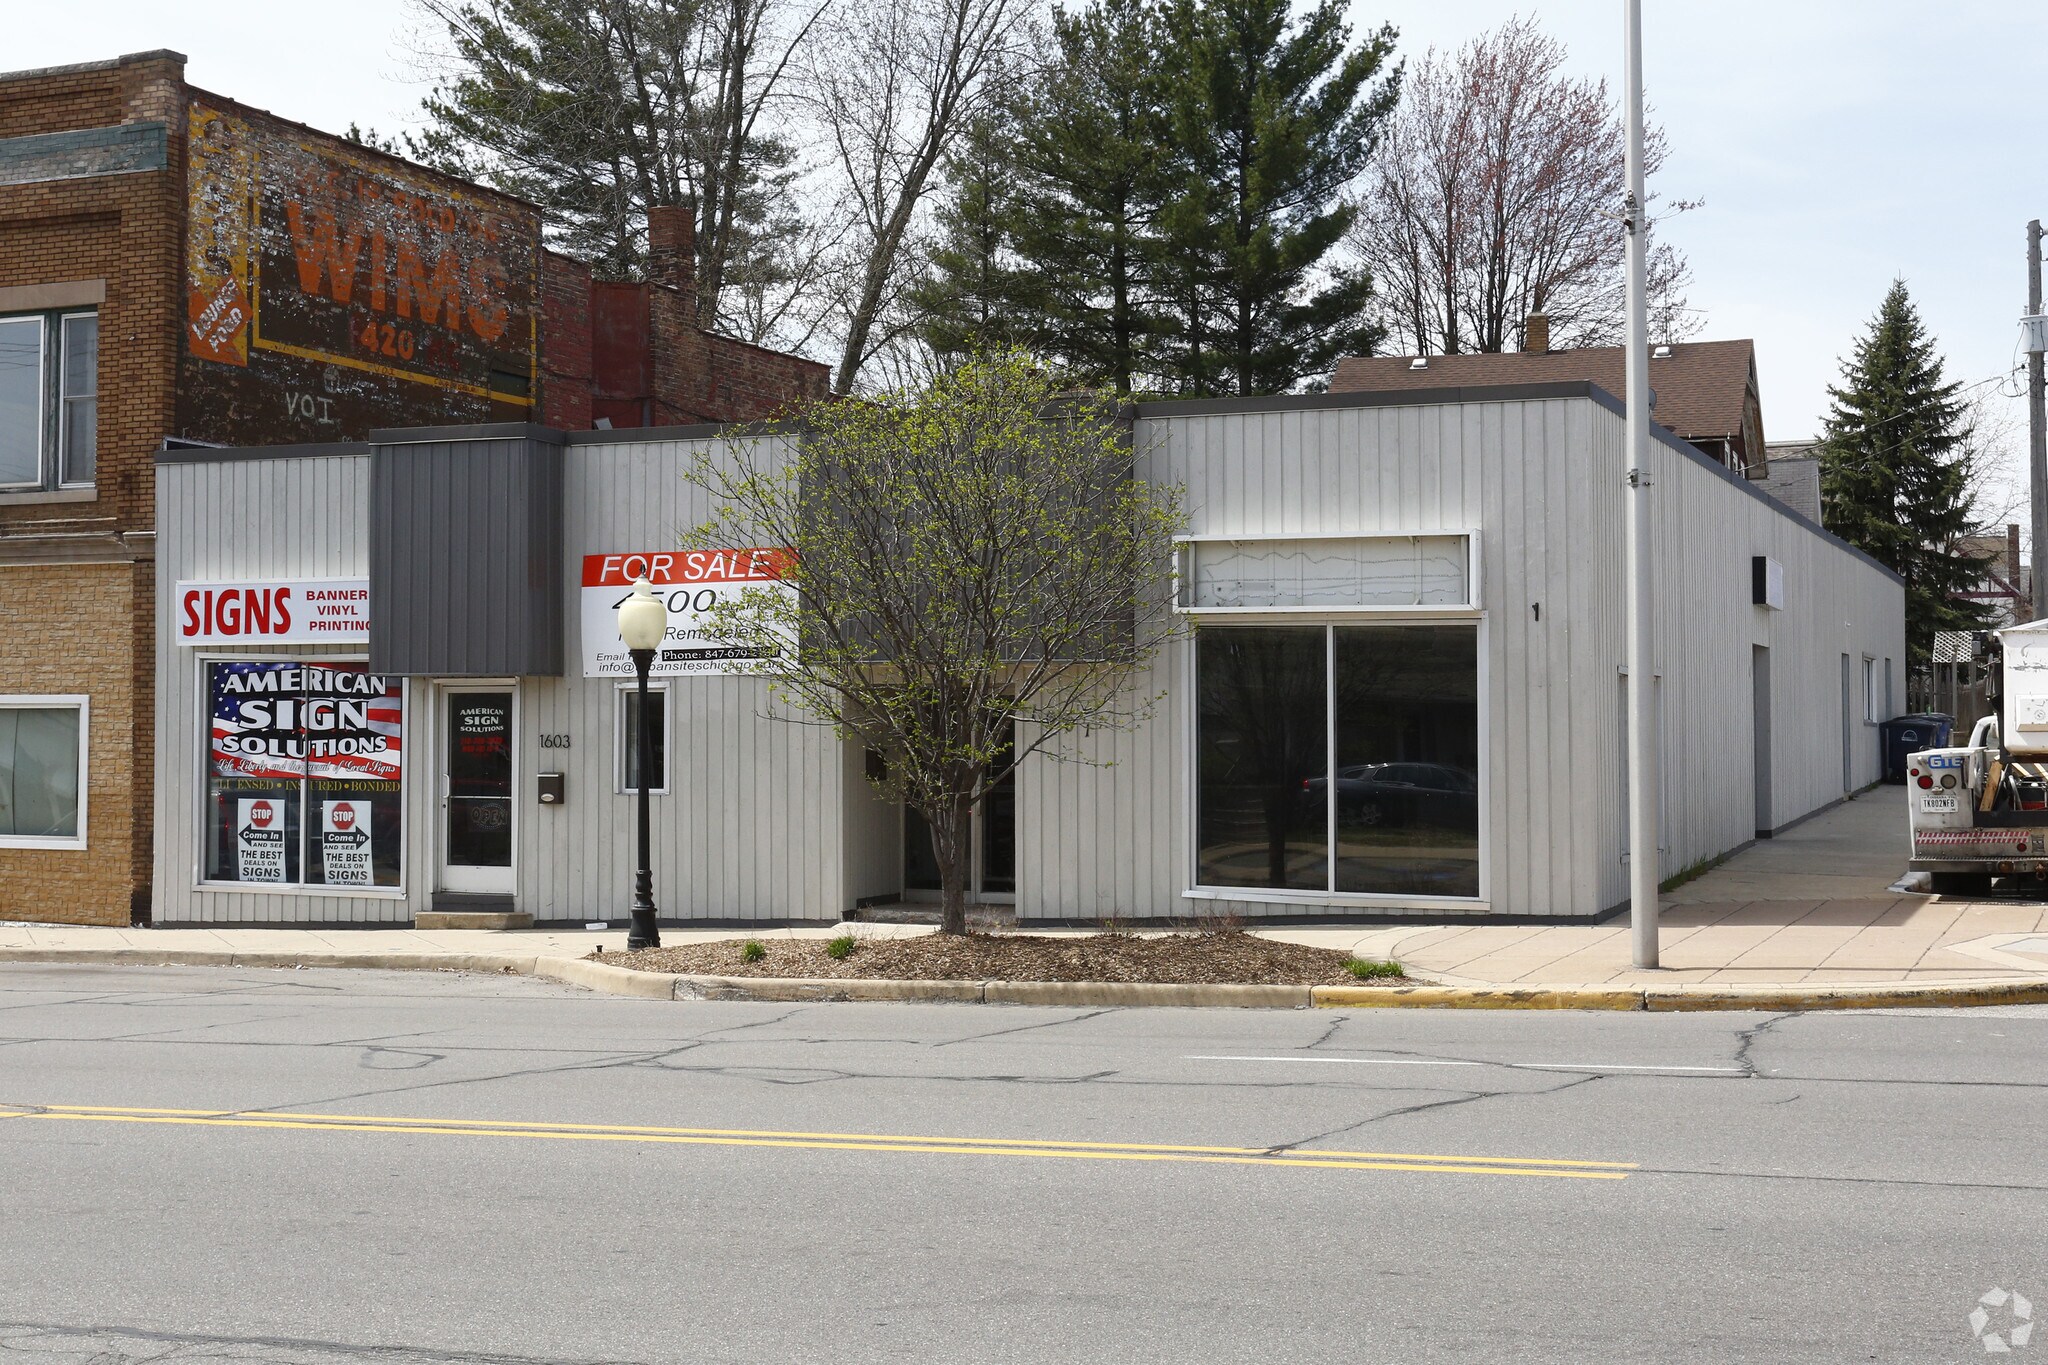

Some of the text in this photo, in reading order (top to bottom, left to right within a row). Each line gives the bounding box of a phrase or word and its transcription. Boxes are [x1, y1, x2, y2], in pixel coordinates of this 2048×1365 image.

[285, 391, 335, 425] VOI
[600, 550, 772, 583] FOR SALE
[183, 587, 292, 637] SIGNS
[317, 605, 358, 616] VINYL
[664, 624, 764, 641] Remdele
[596, 652, 626, 661] Email
[663, 651, 702, 660] Phone:
[705, 647, 779, 658] 847-679-
[222, 669, 386, 695] AMERICAN
[238, 700, 369, 730] SIGN
[460, 707, 504, 716] AMERICAN
[464, 716, 499, 725] SIGN
[460, 725, 504, 733] SOLUTIONS
[222, 735, 388, 759] SOLUTIONS
[539, 734, 571, 749] 1603
[344, 760, 370, 773] Great
[369, 760, 396, 775] Signs
[1930, 756, 1963, 767] GTE
[219, 779, 274, 790] LIENSED
[351, 781, 400, 792] BONDED
[252, 808, 272, 820] STOP
[333, 810, 354, 822] STOP
[243, 831, 279, 840] Come In
[328, 833, 366, 842] Come In
[241, 850, 283, 860] THE BEST
[326, 853, 369, 863] THE BEST
[242, 867, 281, 878] SIGNS
[328, 870, 368, 880] SIGNS
